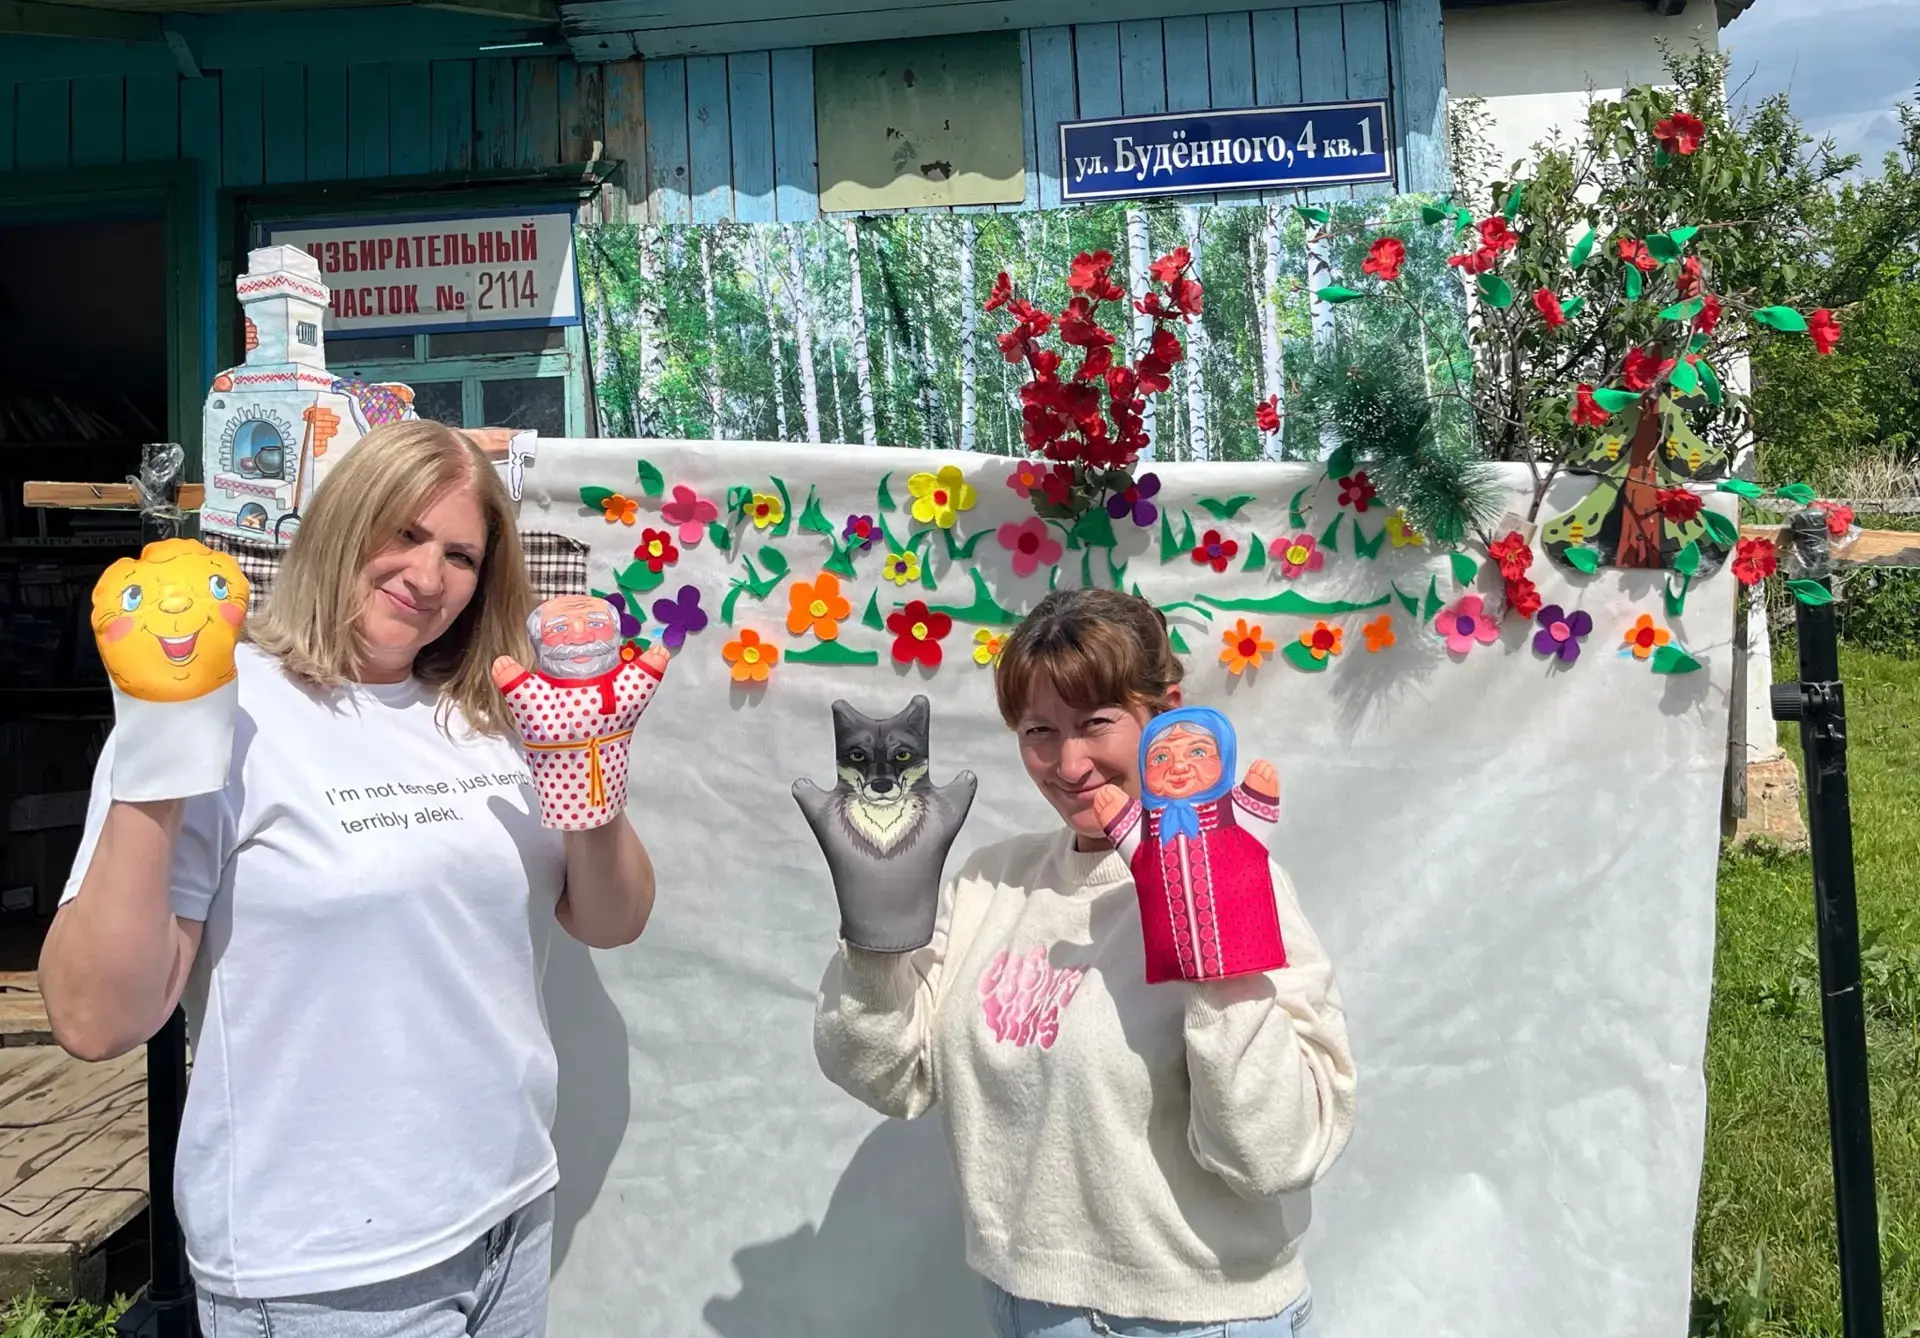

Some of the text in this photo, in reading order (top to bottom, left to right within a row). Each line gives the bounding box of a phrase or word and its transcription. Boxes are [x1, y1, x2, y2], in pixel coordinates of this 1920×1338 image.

[1074, 156, 1109, 183] ул.
[307, 222, 538, 274] ИЗБИРАТЕЛЬНЫЙ
[329, 269, 539, 319] ЧАСТОК № 2114
[364, 782, 398, 799] not
[398, 781, 457, 796] tense,
[456, 773, 493, 793] just
[341, 811, 409, 834] terribly
